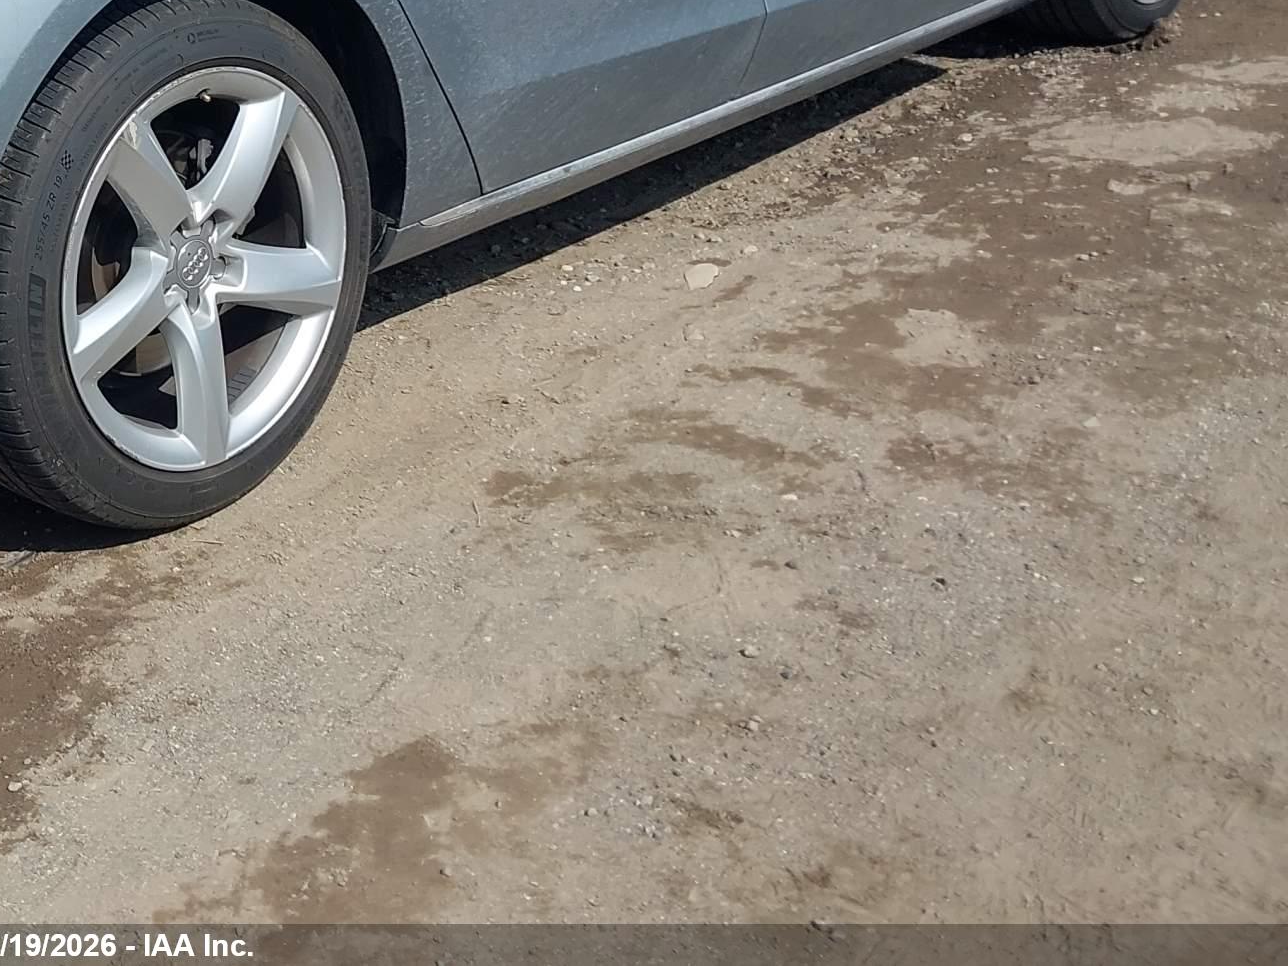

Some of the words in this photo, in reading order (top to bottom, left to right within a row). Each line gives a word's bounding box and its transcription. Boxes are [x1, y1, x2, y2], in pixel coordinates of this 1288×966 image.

[34, 212, 51, 261] 255/45
[46, 191, 57, 210] ZR
[53, 175, 63, 189] 19
